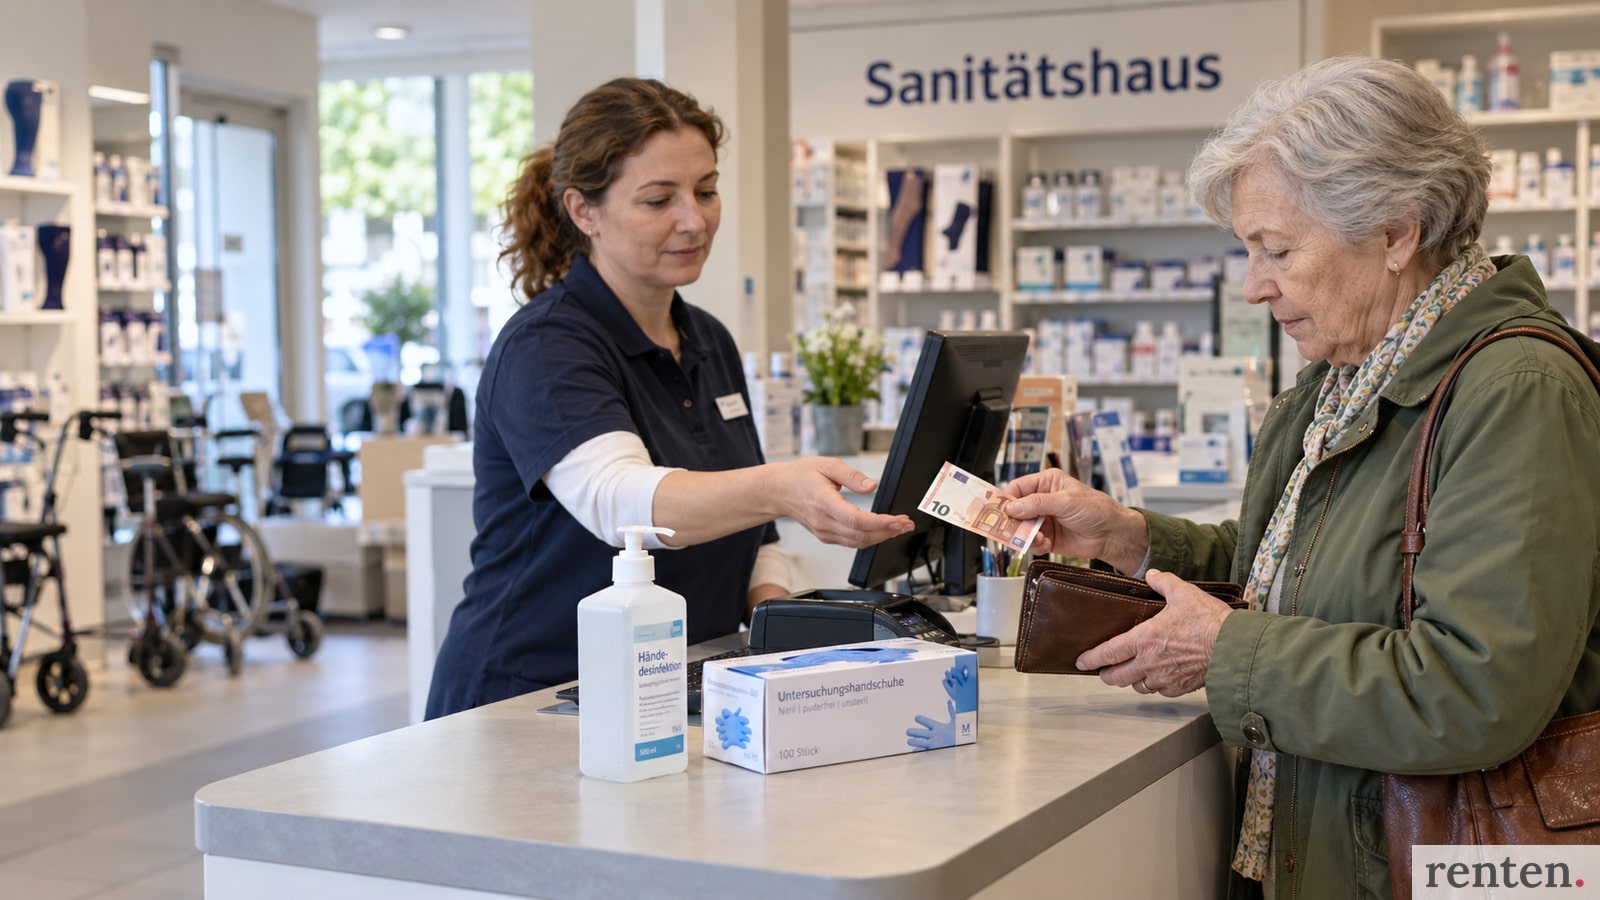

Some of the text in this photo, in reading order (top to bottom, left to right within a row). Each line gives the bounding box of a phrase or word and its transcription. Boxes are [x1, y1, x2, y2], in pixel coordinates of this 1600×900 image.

[865, 48, 1222, 106] Sanitätshaus
[931, 500, 951, 517] 10
[638, 650, 668, 663] Hände-
[638, 661, 682, 677] desinfektion
[778, 677, 905, 702] Untersuchungshandschuhe
[778, 705, 796, 715] Nitril
[803, 700, 836, 714] puderfrei
[841, 695, 868, 707] unsteril
[961, 723, 970, 734] M
[779, 746, 819, 760] 100 Stück
